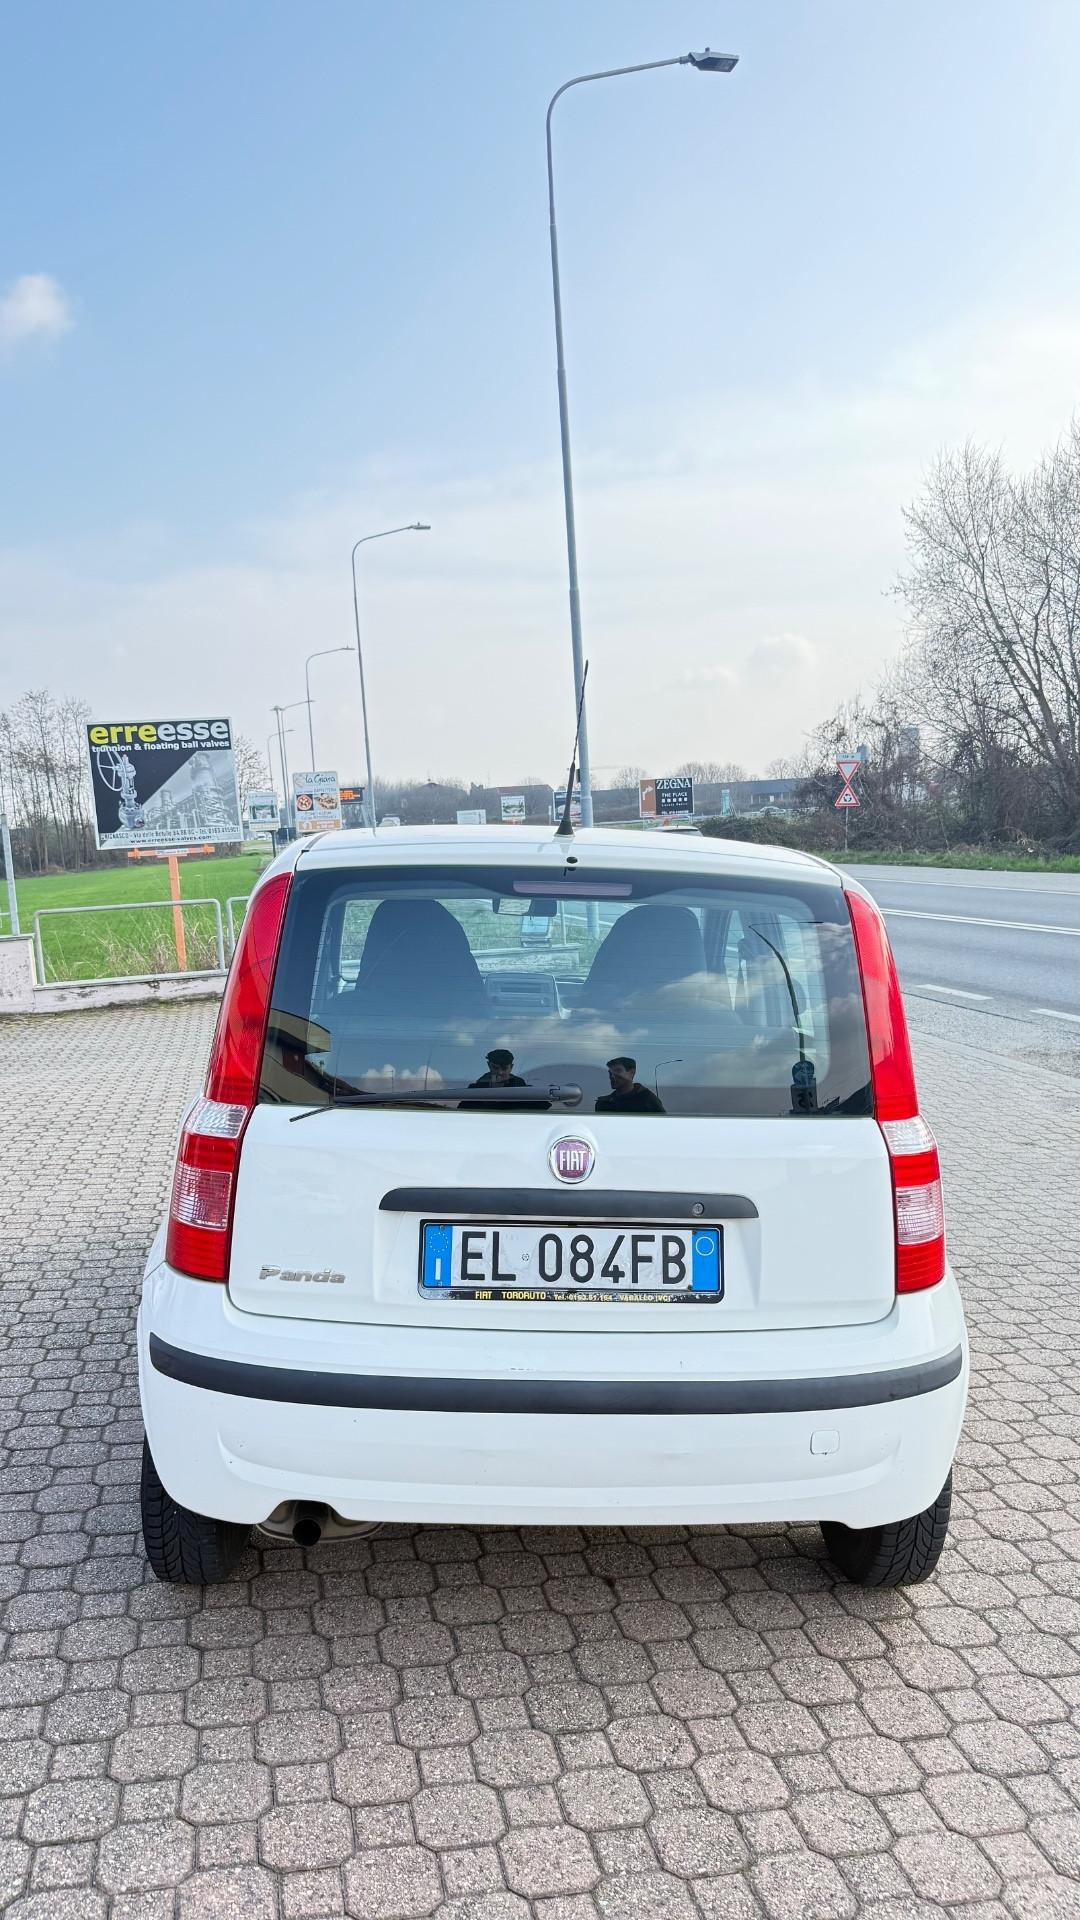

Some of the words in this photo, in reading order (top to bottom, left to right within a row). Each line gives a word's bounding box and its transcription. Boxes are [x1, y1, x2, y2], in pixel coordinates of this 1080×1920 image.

[89, 721, 229, 745] erreesse
[92, 743, 132, 752] trunnion
[134, 742, 142, 750] &
[144, 741, 180, 751] floating
[181, 740, 199, 749] ball
[200, 739, 230, 748] valves
[655, 778, 692, 790] ZEGNA
[559, 1150, 587, 1171] FIAT
[460, 1230, 517, 1282] EL
[538, 1232, 687, 1285] 084FB
[259, 1264, 346, 1284] Panda
[475, 1290, 493, 1300] FIAT
[501, 1291, 547, 1300] TOROAUTO
